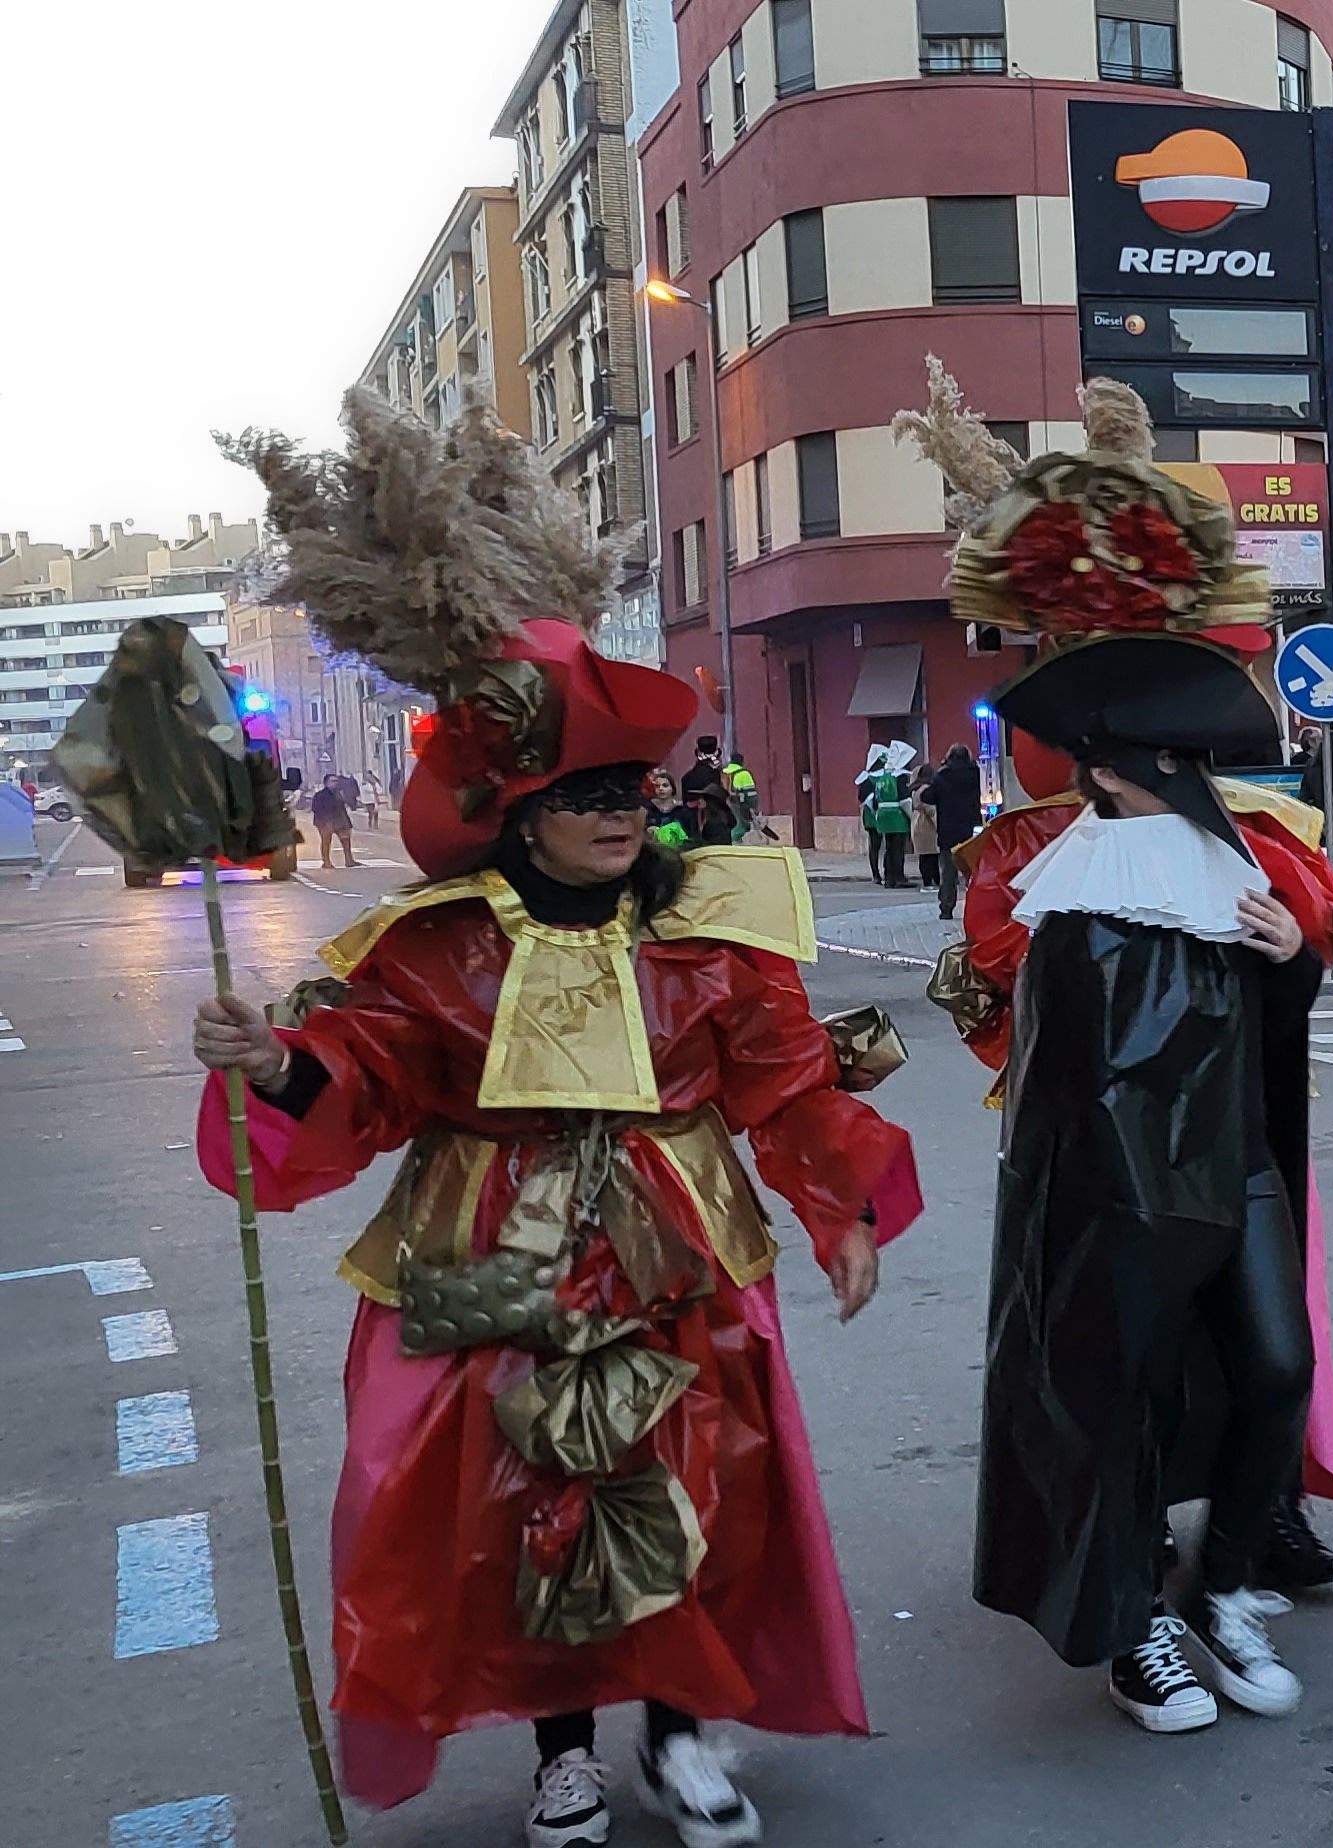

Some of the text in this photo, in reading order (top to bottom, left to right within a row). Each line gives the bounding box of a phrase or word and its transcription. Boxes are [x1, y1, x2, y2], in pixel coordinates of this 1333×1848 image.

[1118, 247, 1275, 278] REPSOL
[1094, 315, 1123, 326] Diesel
[1264, 476, 1292, 496] ES
[1240, 503, 1319, 523] GRATIS
[1289, 591, 1323, 605] más
